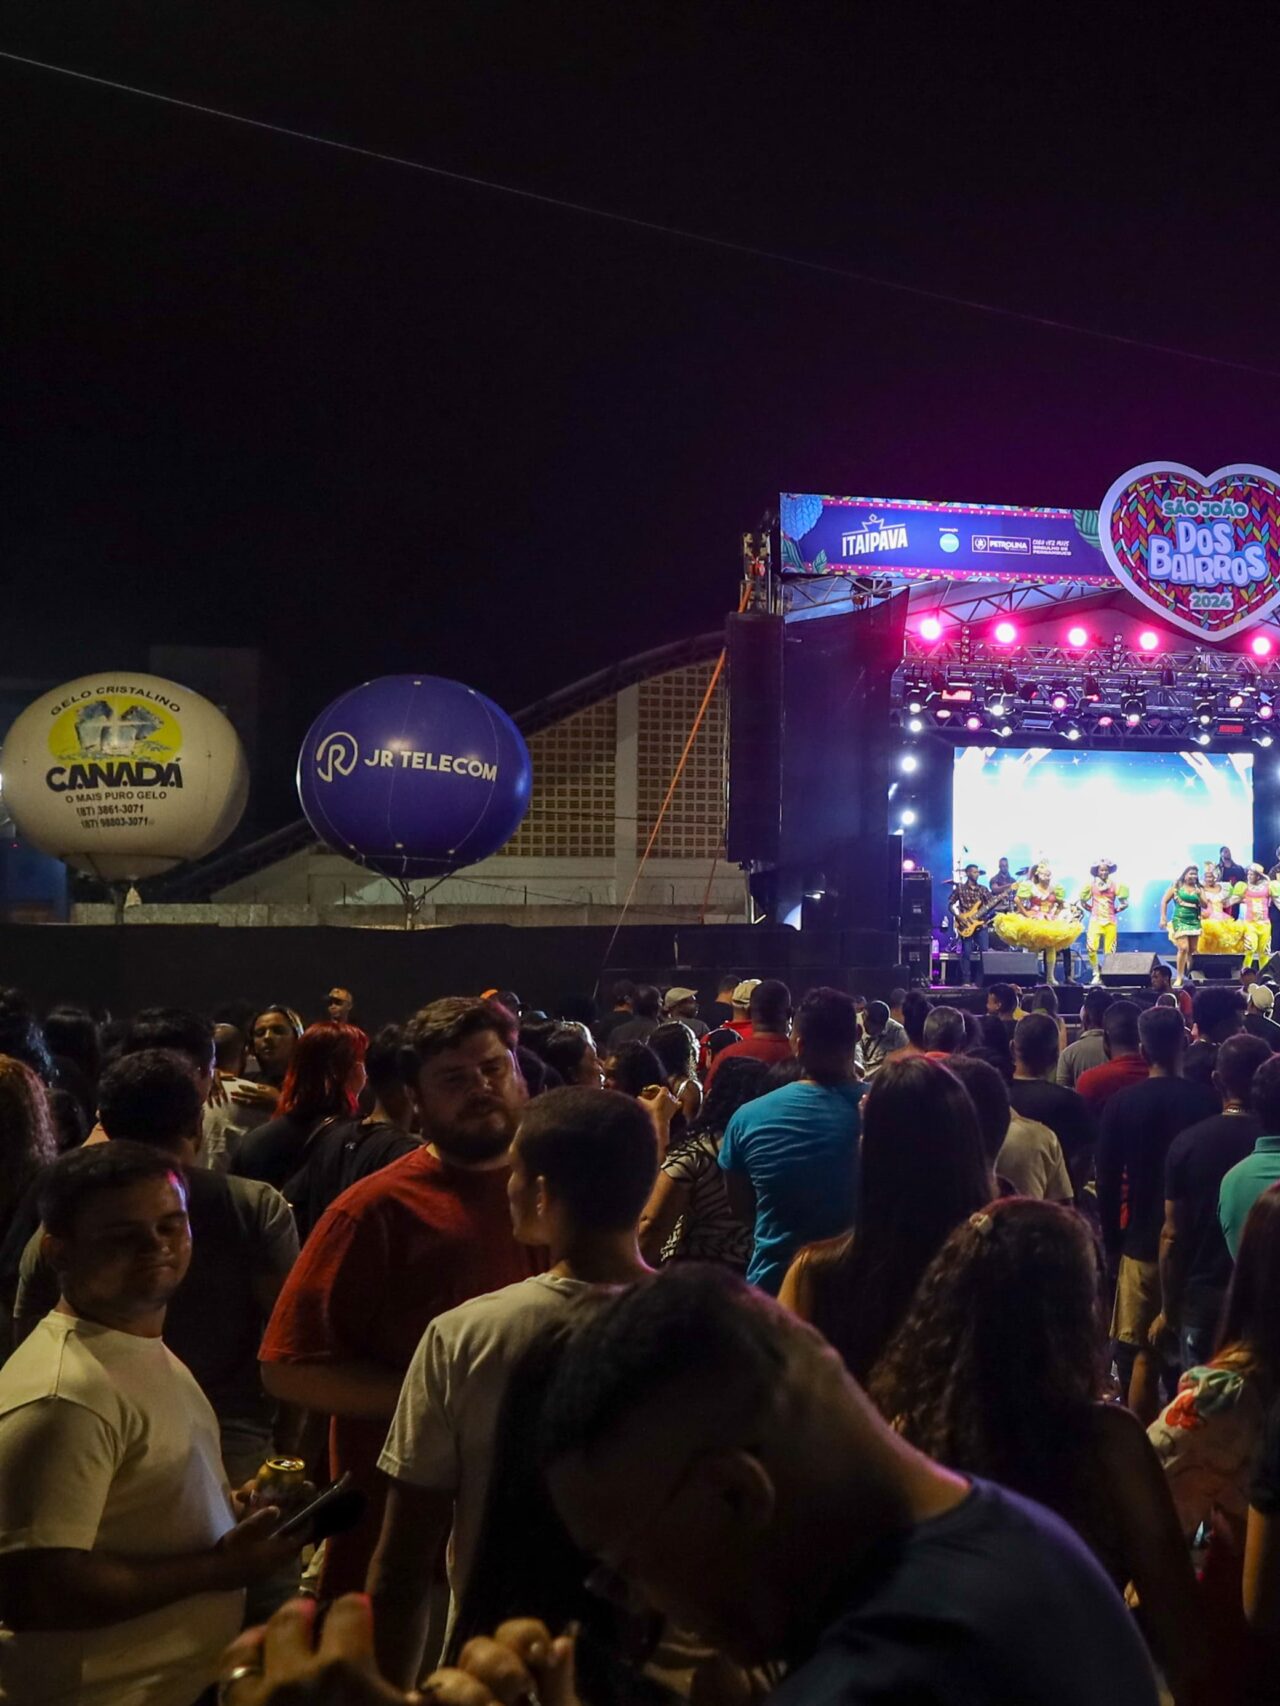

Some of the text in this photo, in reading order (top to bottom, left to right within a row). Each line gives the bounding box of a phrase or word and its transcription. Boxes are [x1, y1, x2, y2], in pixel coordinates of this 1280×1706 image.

[1163, 497, 1247, 518] SÃO JOÃO
[841, 526, 909, 557] ITAIPAVA
[989, 540, 1028, 551] PETROLINA
[1191, 593, 1231, 609] 2024
[50, 685, 181, 716] GELO CRISTALINO
[363, 749, 498, 782] JR TELECOM
[65, 790, 168, 804] O MAIS PURO GELO
